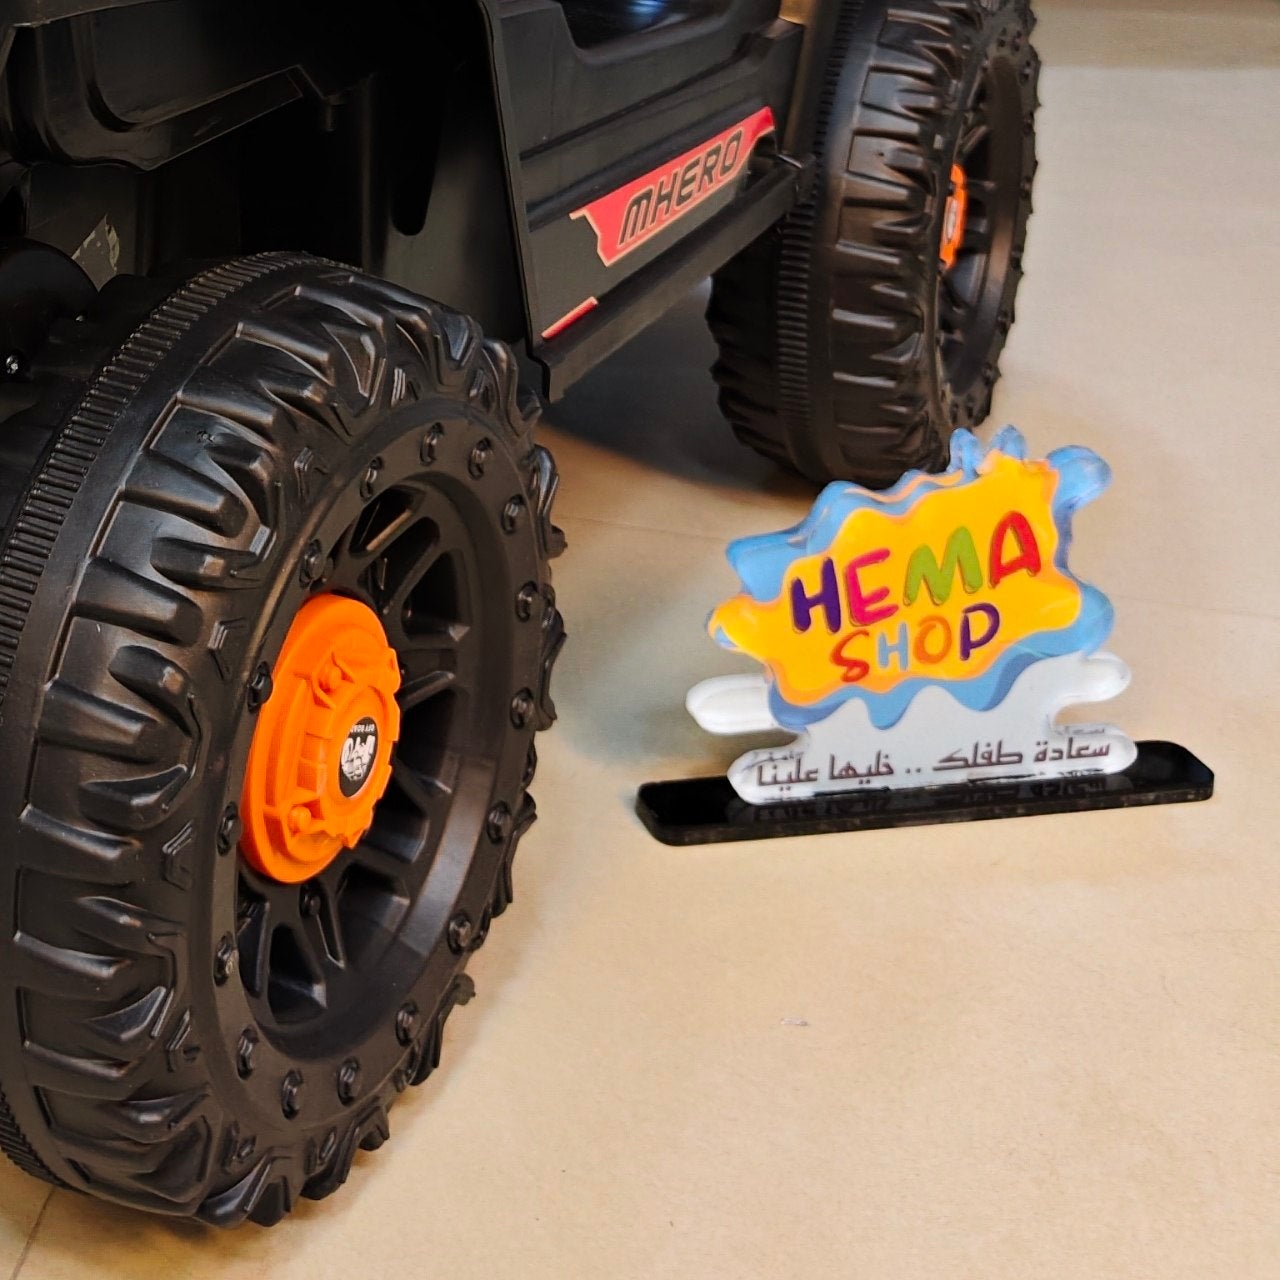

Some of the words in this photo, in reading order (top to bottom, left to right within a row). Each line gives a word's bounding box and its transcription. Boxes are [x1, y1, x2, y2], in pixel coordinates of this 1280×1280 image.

[619, 128, 743, 247] MHERO
[790, 510, 1042, 634] HEMA
[830, 602, 1001, 683] SHOP
[828, 750, 894, 785] خليها
[932, 740, 1024, 772] طفلك
[1033, 737, 1111, 763] سعادة
